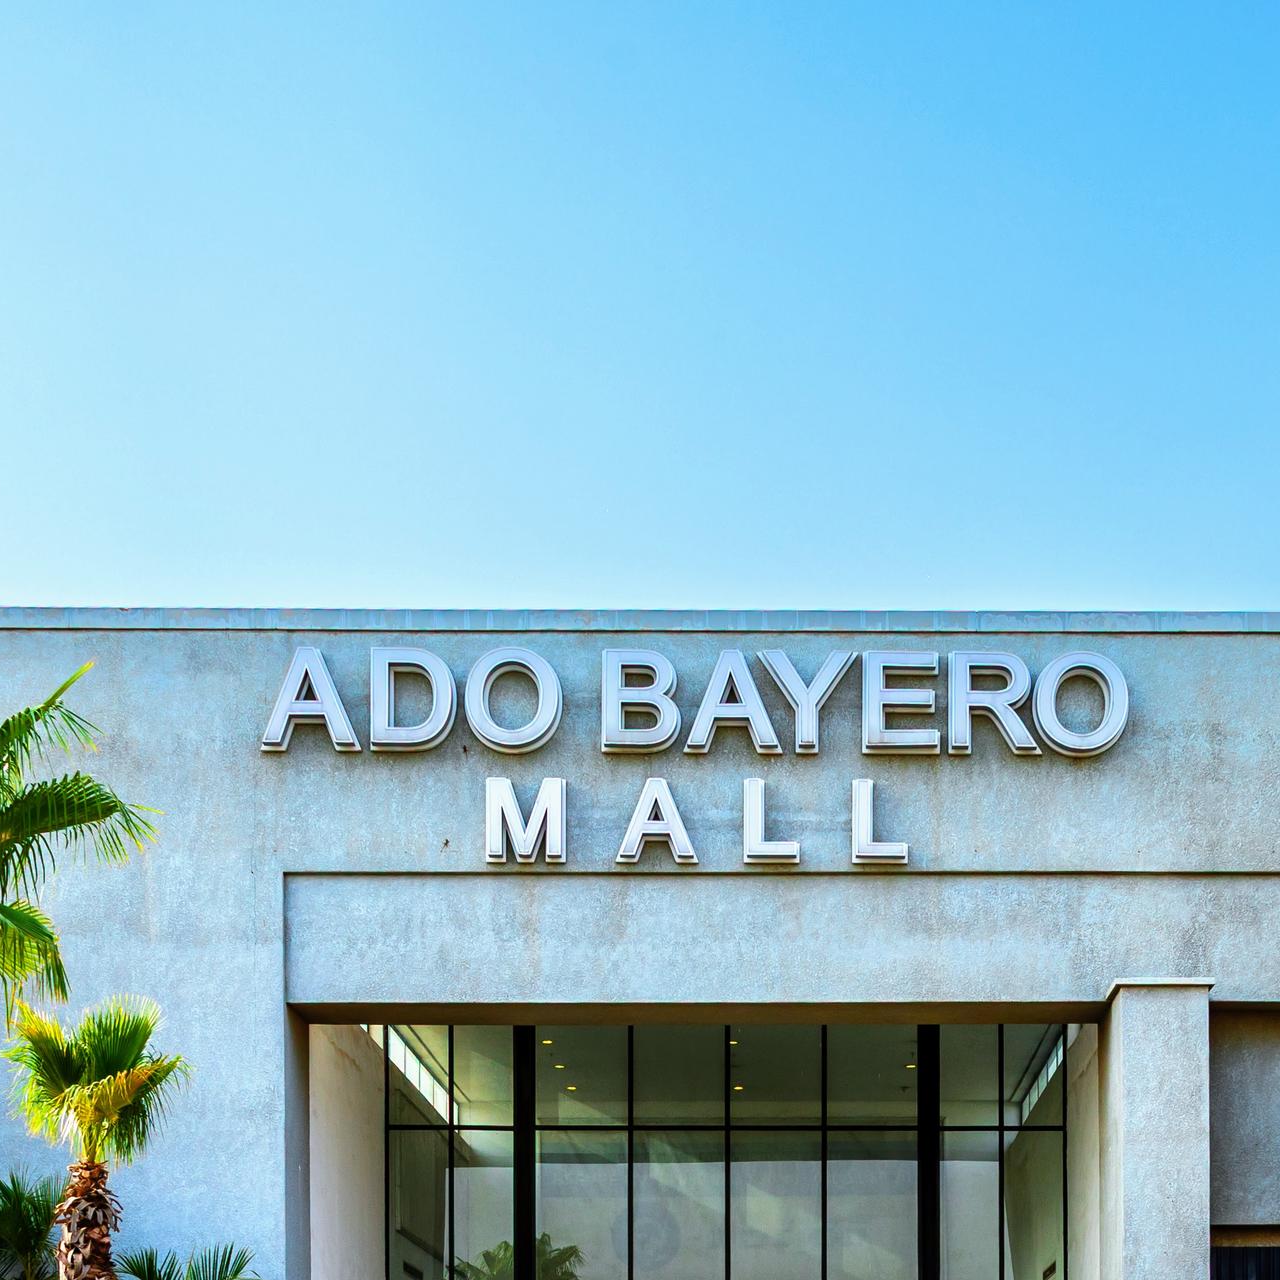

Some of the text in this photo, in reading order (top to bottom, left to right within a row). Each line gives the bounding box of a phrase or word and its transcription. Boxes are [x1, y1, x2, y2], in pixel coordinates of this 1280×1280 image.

[261, 647, 1130, 758] ADO BAYERO
[485, 776, 909, 865] MALL
